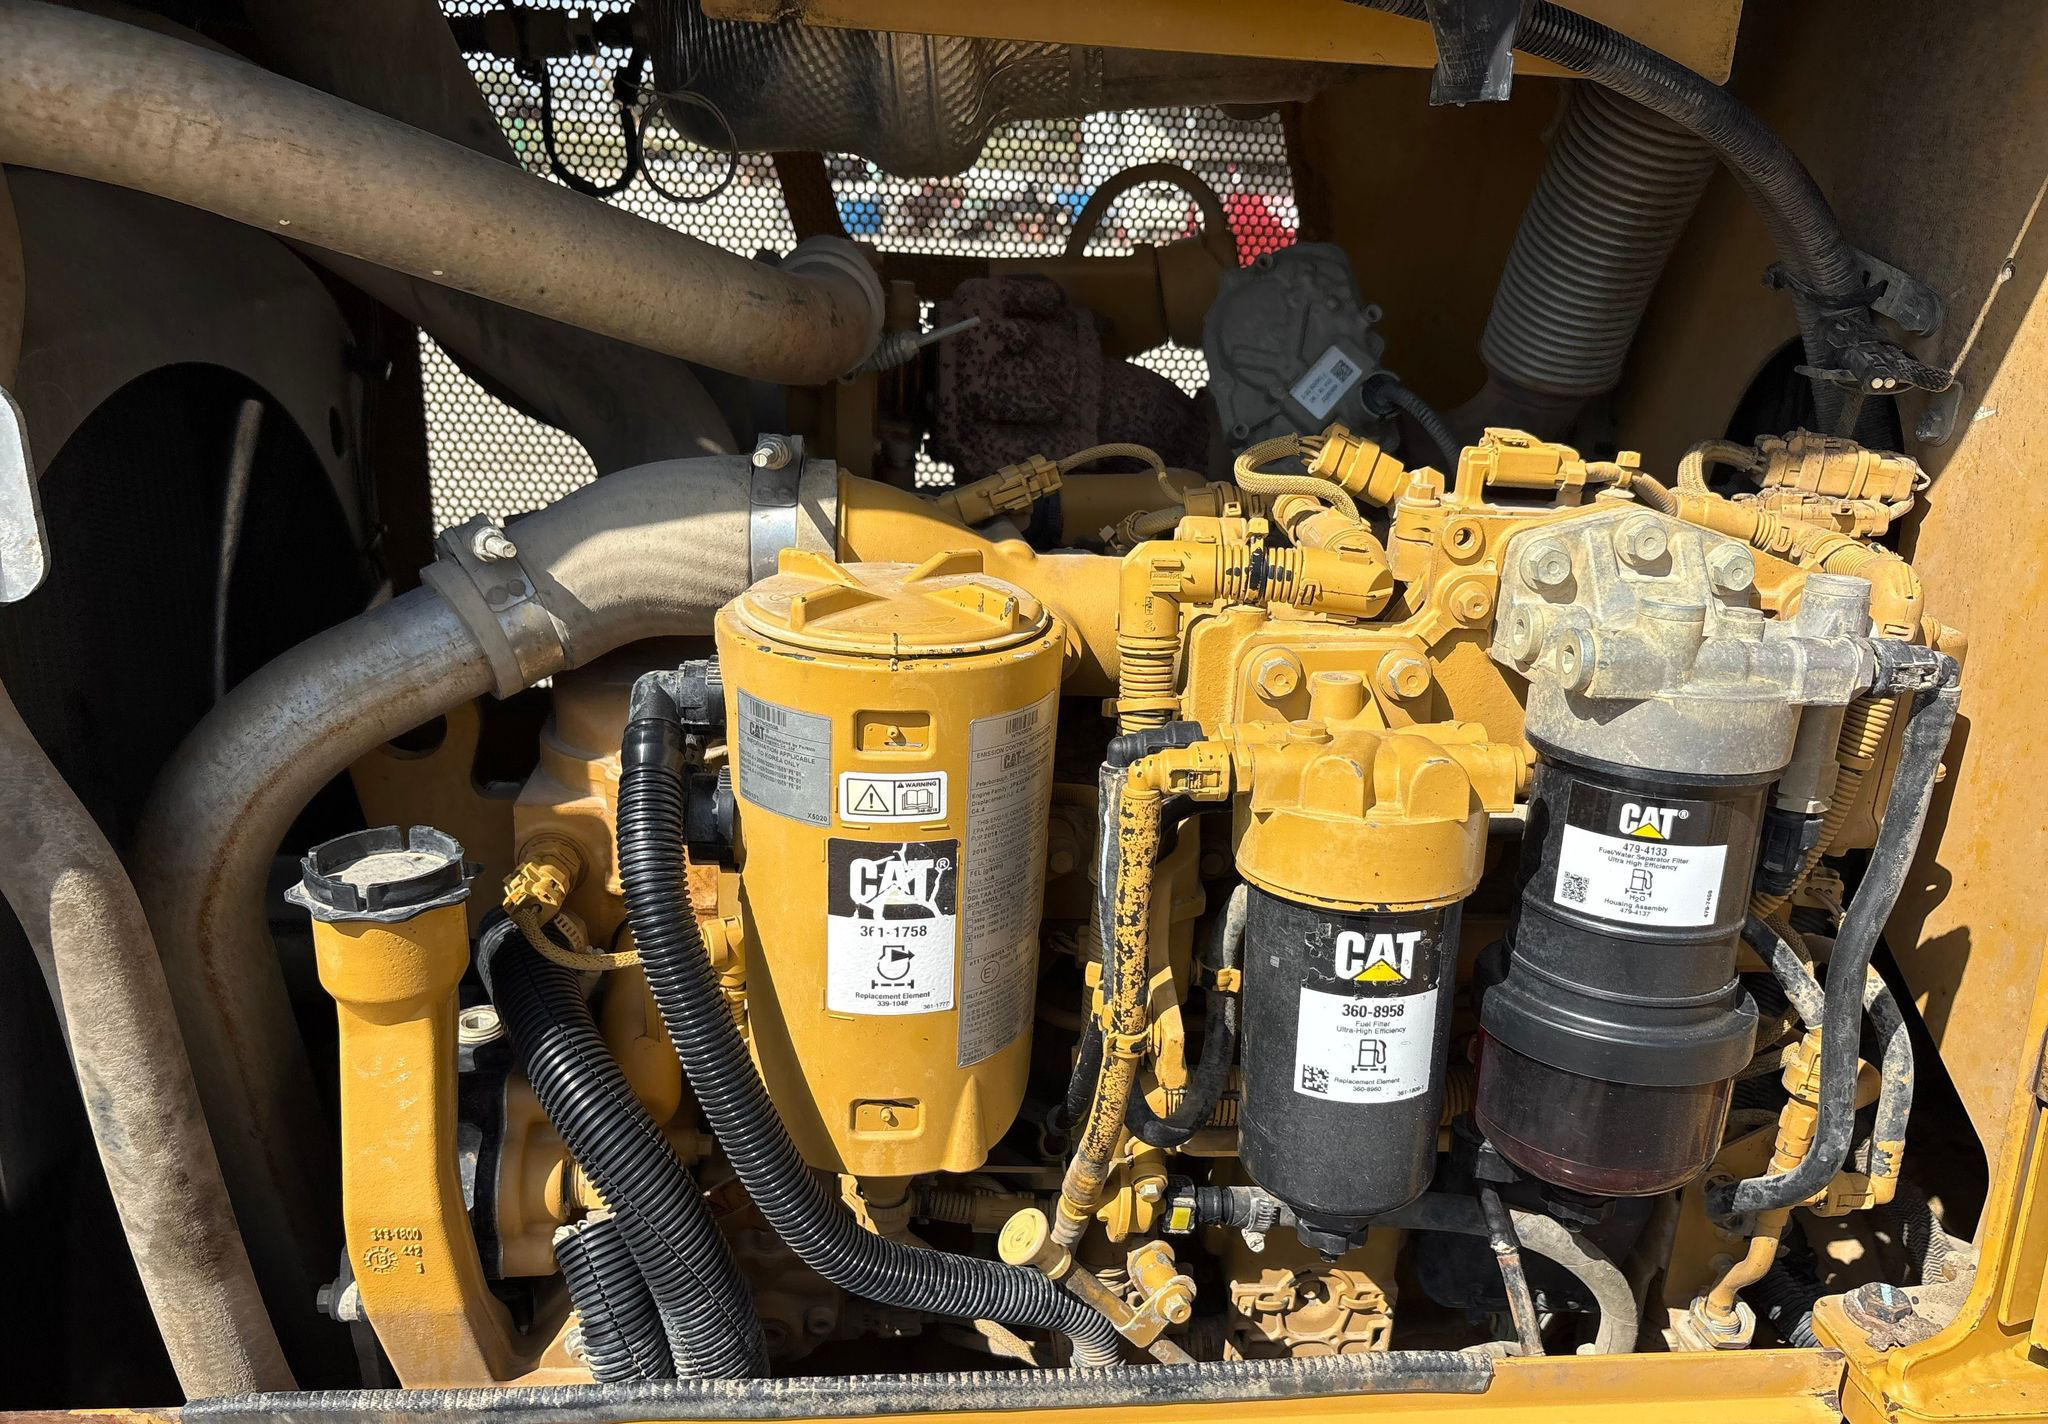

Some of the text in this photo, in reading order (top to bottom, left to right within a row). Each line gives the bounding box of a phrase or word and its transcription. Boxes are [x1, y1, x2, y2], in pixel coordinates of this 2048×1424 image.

[765, 751, 783, 763] KOREA
[784, 759, 800, 768] ONLY
[779, 750, 816, 764] APPLICABLE
[807, 812, 828, 822] X5020
[1622, 842, 1668, 857] 479-4133
[1607, 856, 1678, 871] Ultra High Efficiency
[1636, 853, 1670, 864] Separator
[1604, 897, 1669, 913] Housing Assembly
[855, 991, 931, 1000] Replacement Element
[1341, 1003, 1405, 1018] 360-8958
[1355, 1020, 1391, 1028] Fuel Filter
[1336, 1026, 1407, 1035] Ultra-High Efficiency
[1333, 1076, 1400, 1085] Replacement Element
